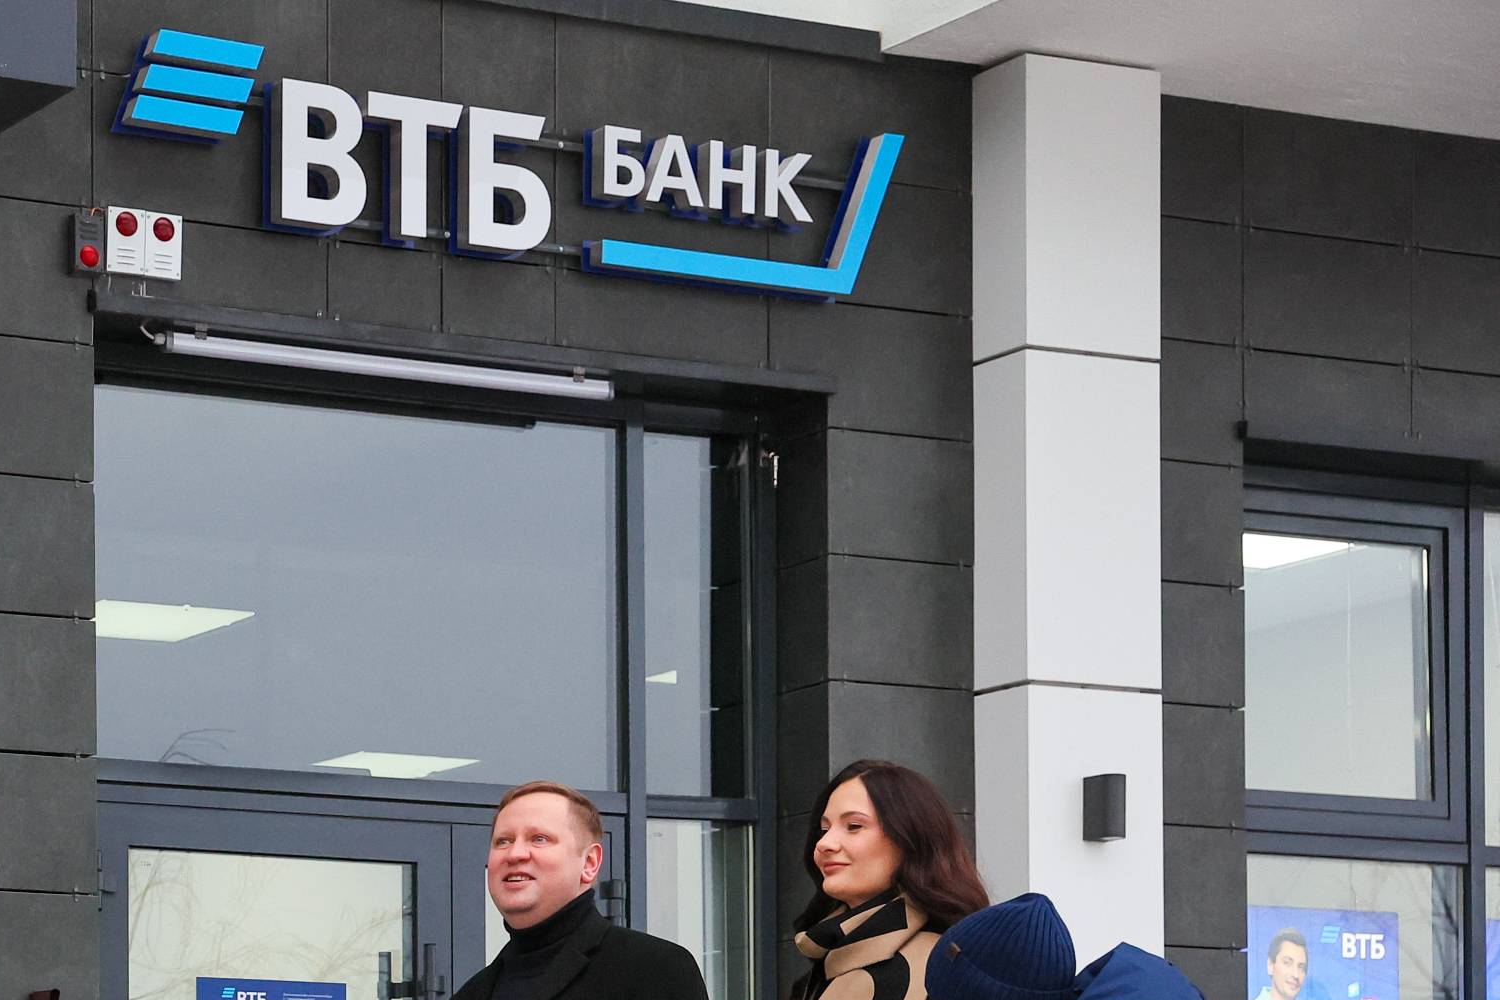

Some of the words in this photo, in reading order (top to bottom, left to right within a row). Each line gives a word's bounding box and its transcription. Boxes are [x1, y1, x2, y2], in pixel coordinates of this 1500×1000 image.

[281, 77, 552, 250] ВТБ
[603, 124, 814, 223] БАНК
[1342, 932, 1386, 960] ВТБ
